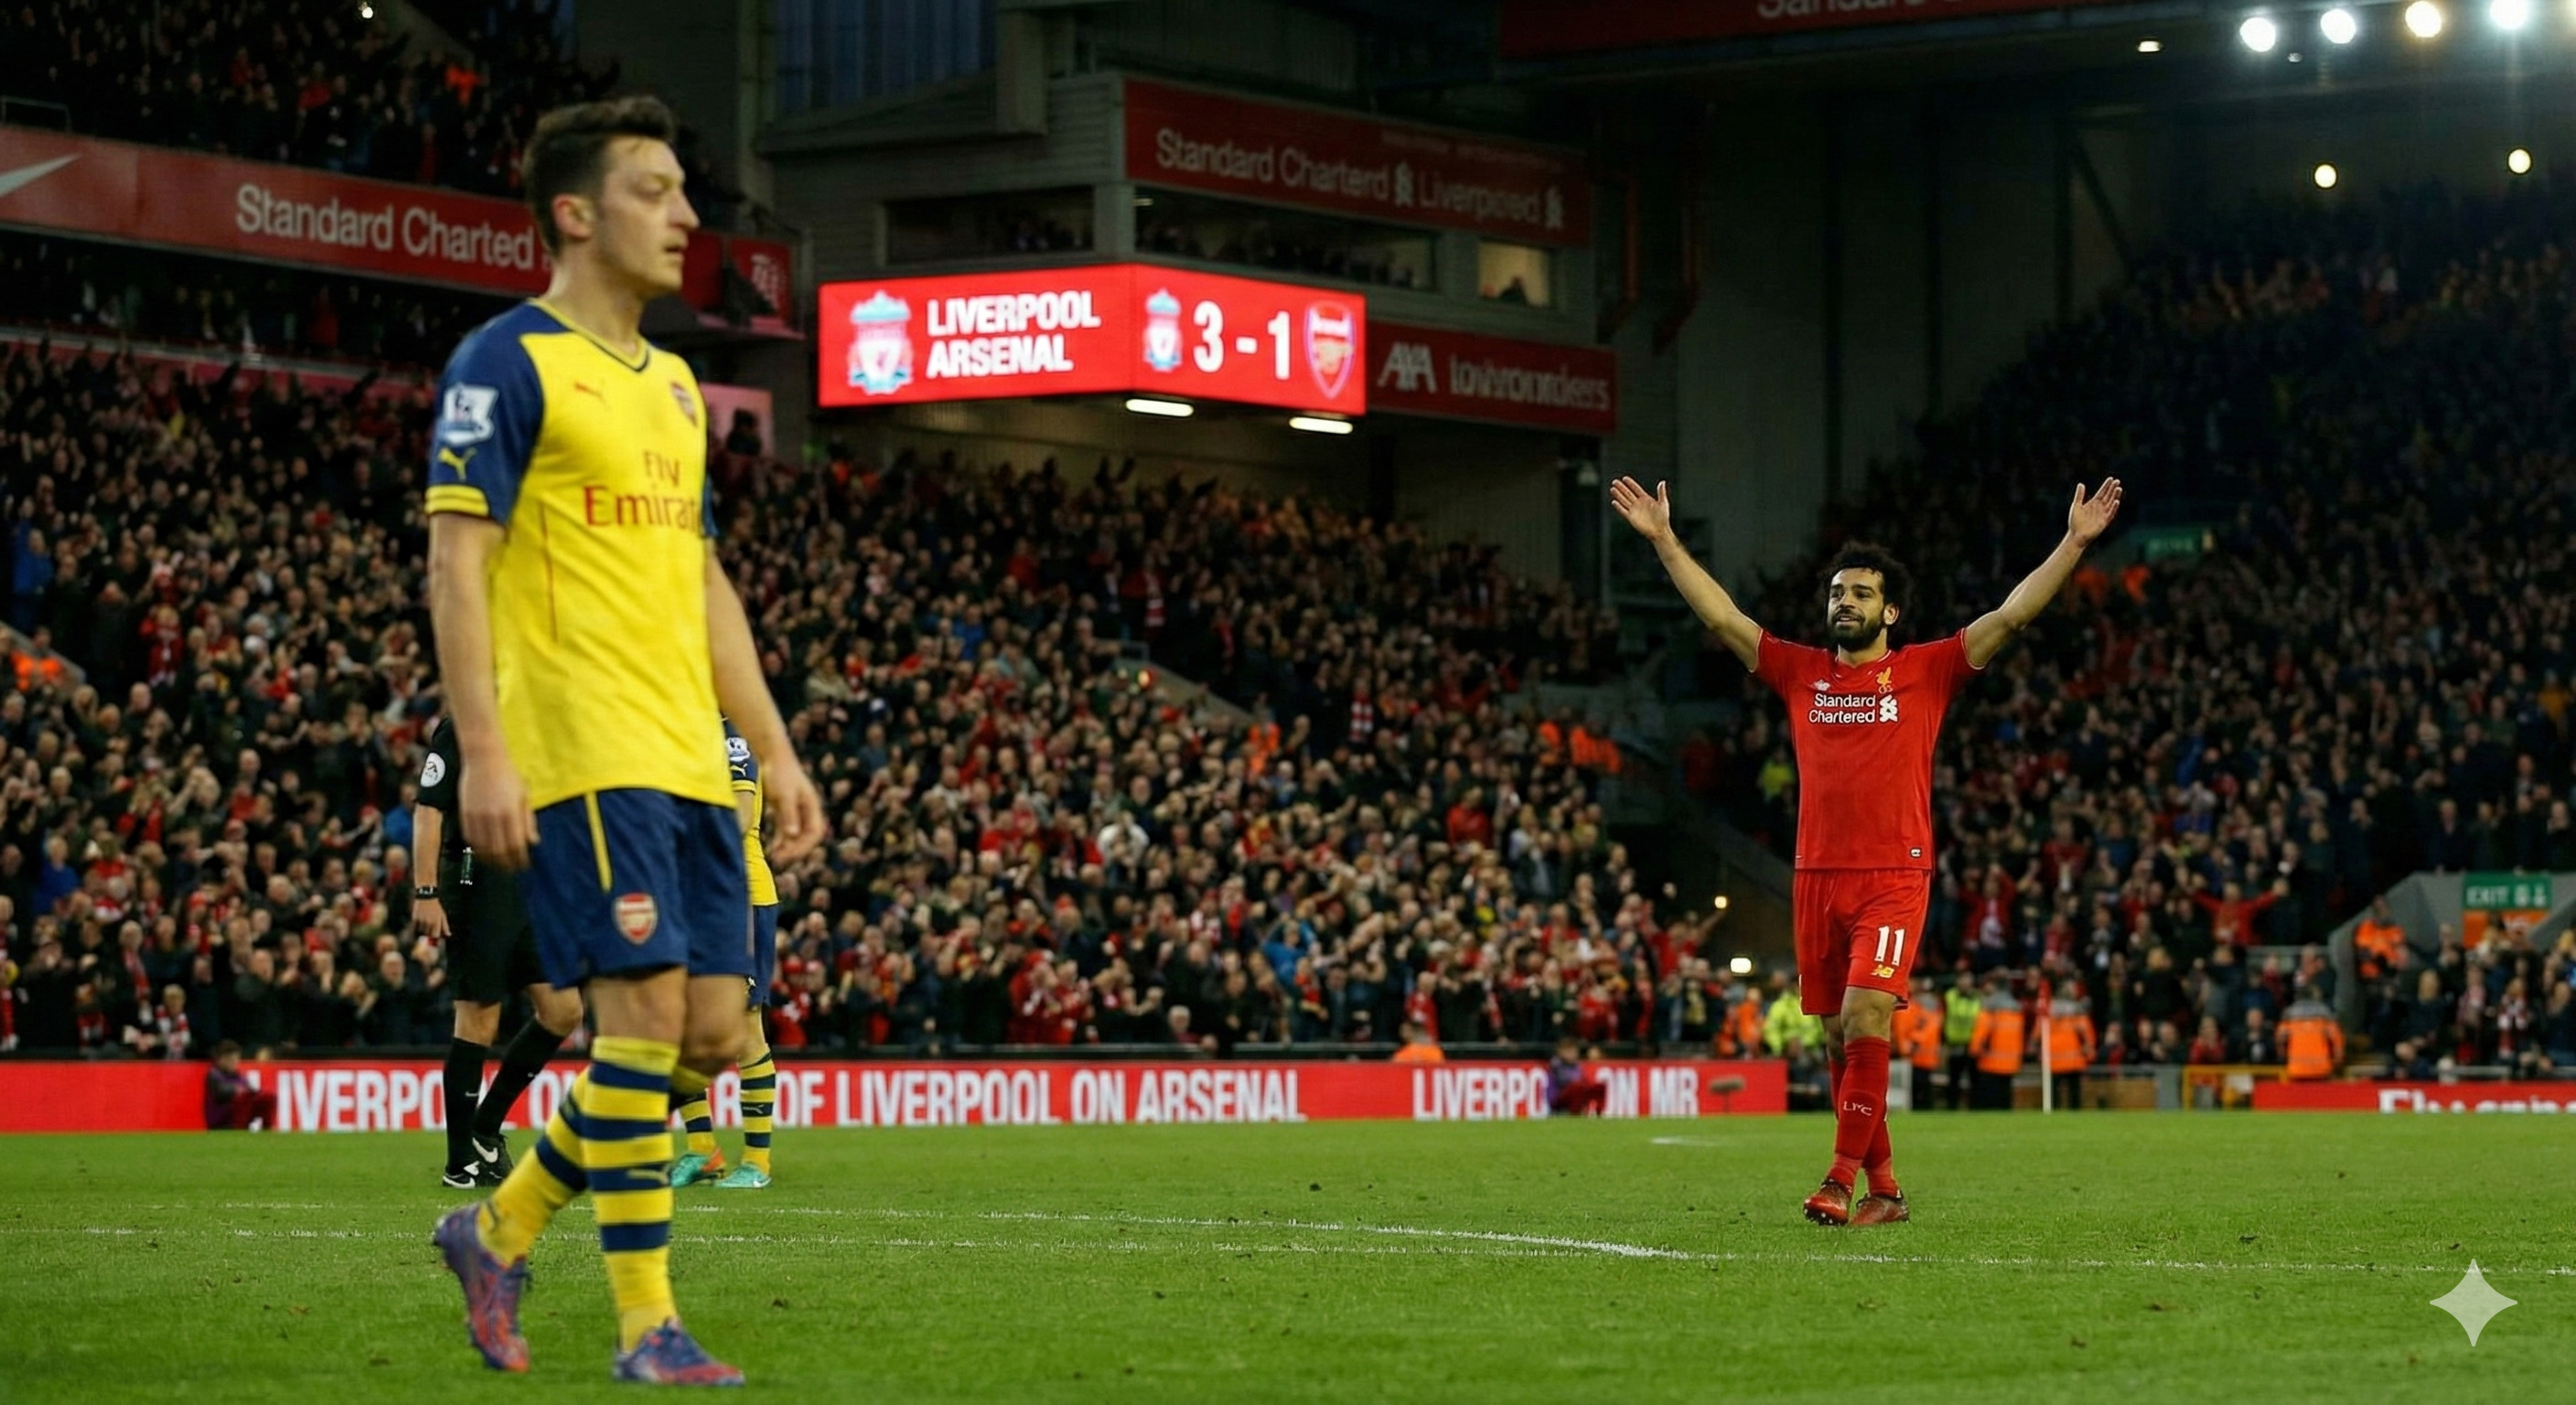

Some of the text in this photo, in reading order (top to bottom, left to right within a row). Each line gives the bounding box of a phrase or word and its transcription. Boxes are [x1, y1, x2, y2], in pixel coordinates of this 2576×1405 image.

[1155, 126, 1275, 183] Standard
[236, 184, 535, 271] Standard Charted
[927, 291, 1101, 337] LIVERPOOL
[925, 334, 1075, 380] ARSENAL
[1193, 300, 1225, 373] 3
[1268, 310, 1291, 381] 1
[644, 450, 680, 488] Fly
[584, 484, 698, 534] Emirat
[1809, 709, 1875, 724] Chartered
[1873, 926, 1905, 967] 11
[774, 1070, 825, 1127] OF
[835, 1069, 1062, 1127] LIVERPOOL
[1071, 1069, 1126, 1124] ON
[1134, 1069, 1309, 1124] ARSENAL
[1412, 1067, 1551, 1120] LIVERPO
[1650, 1067, 1700, 1119] MR
